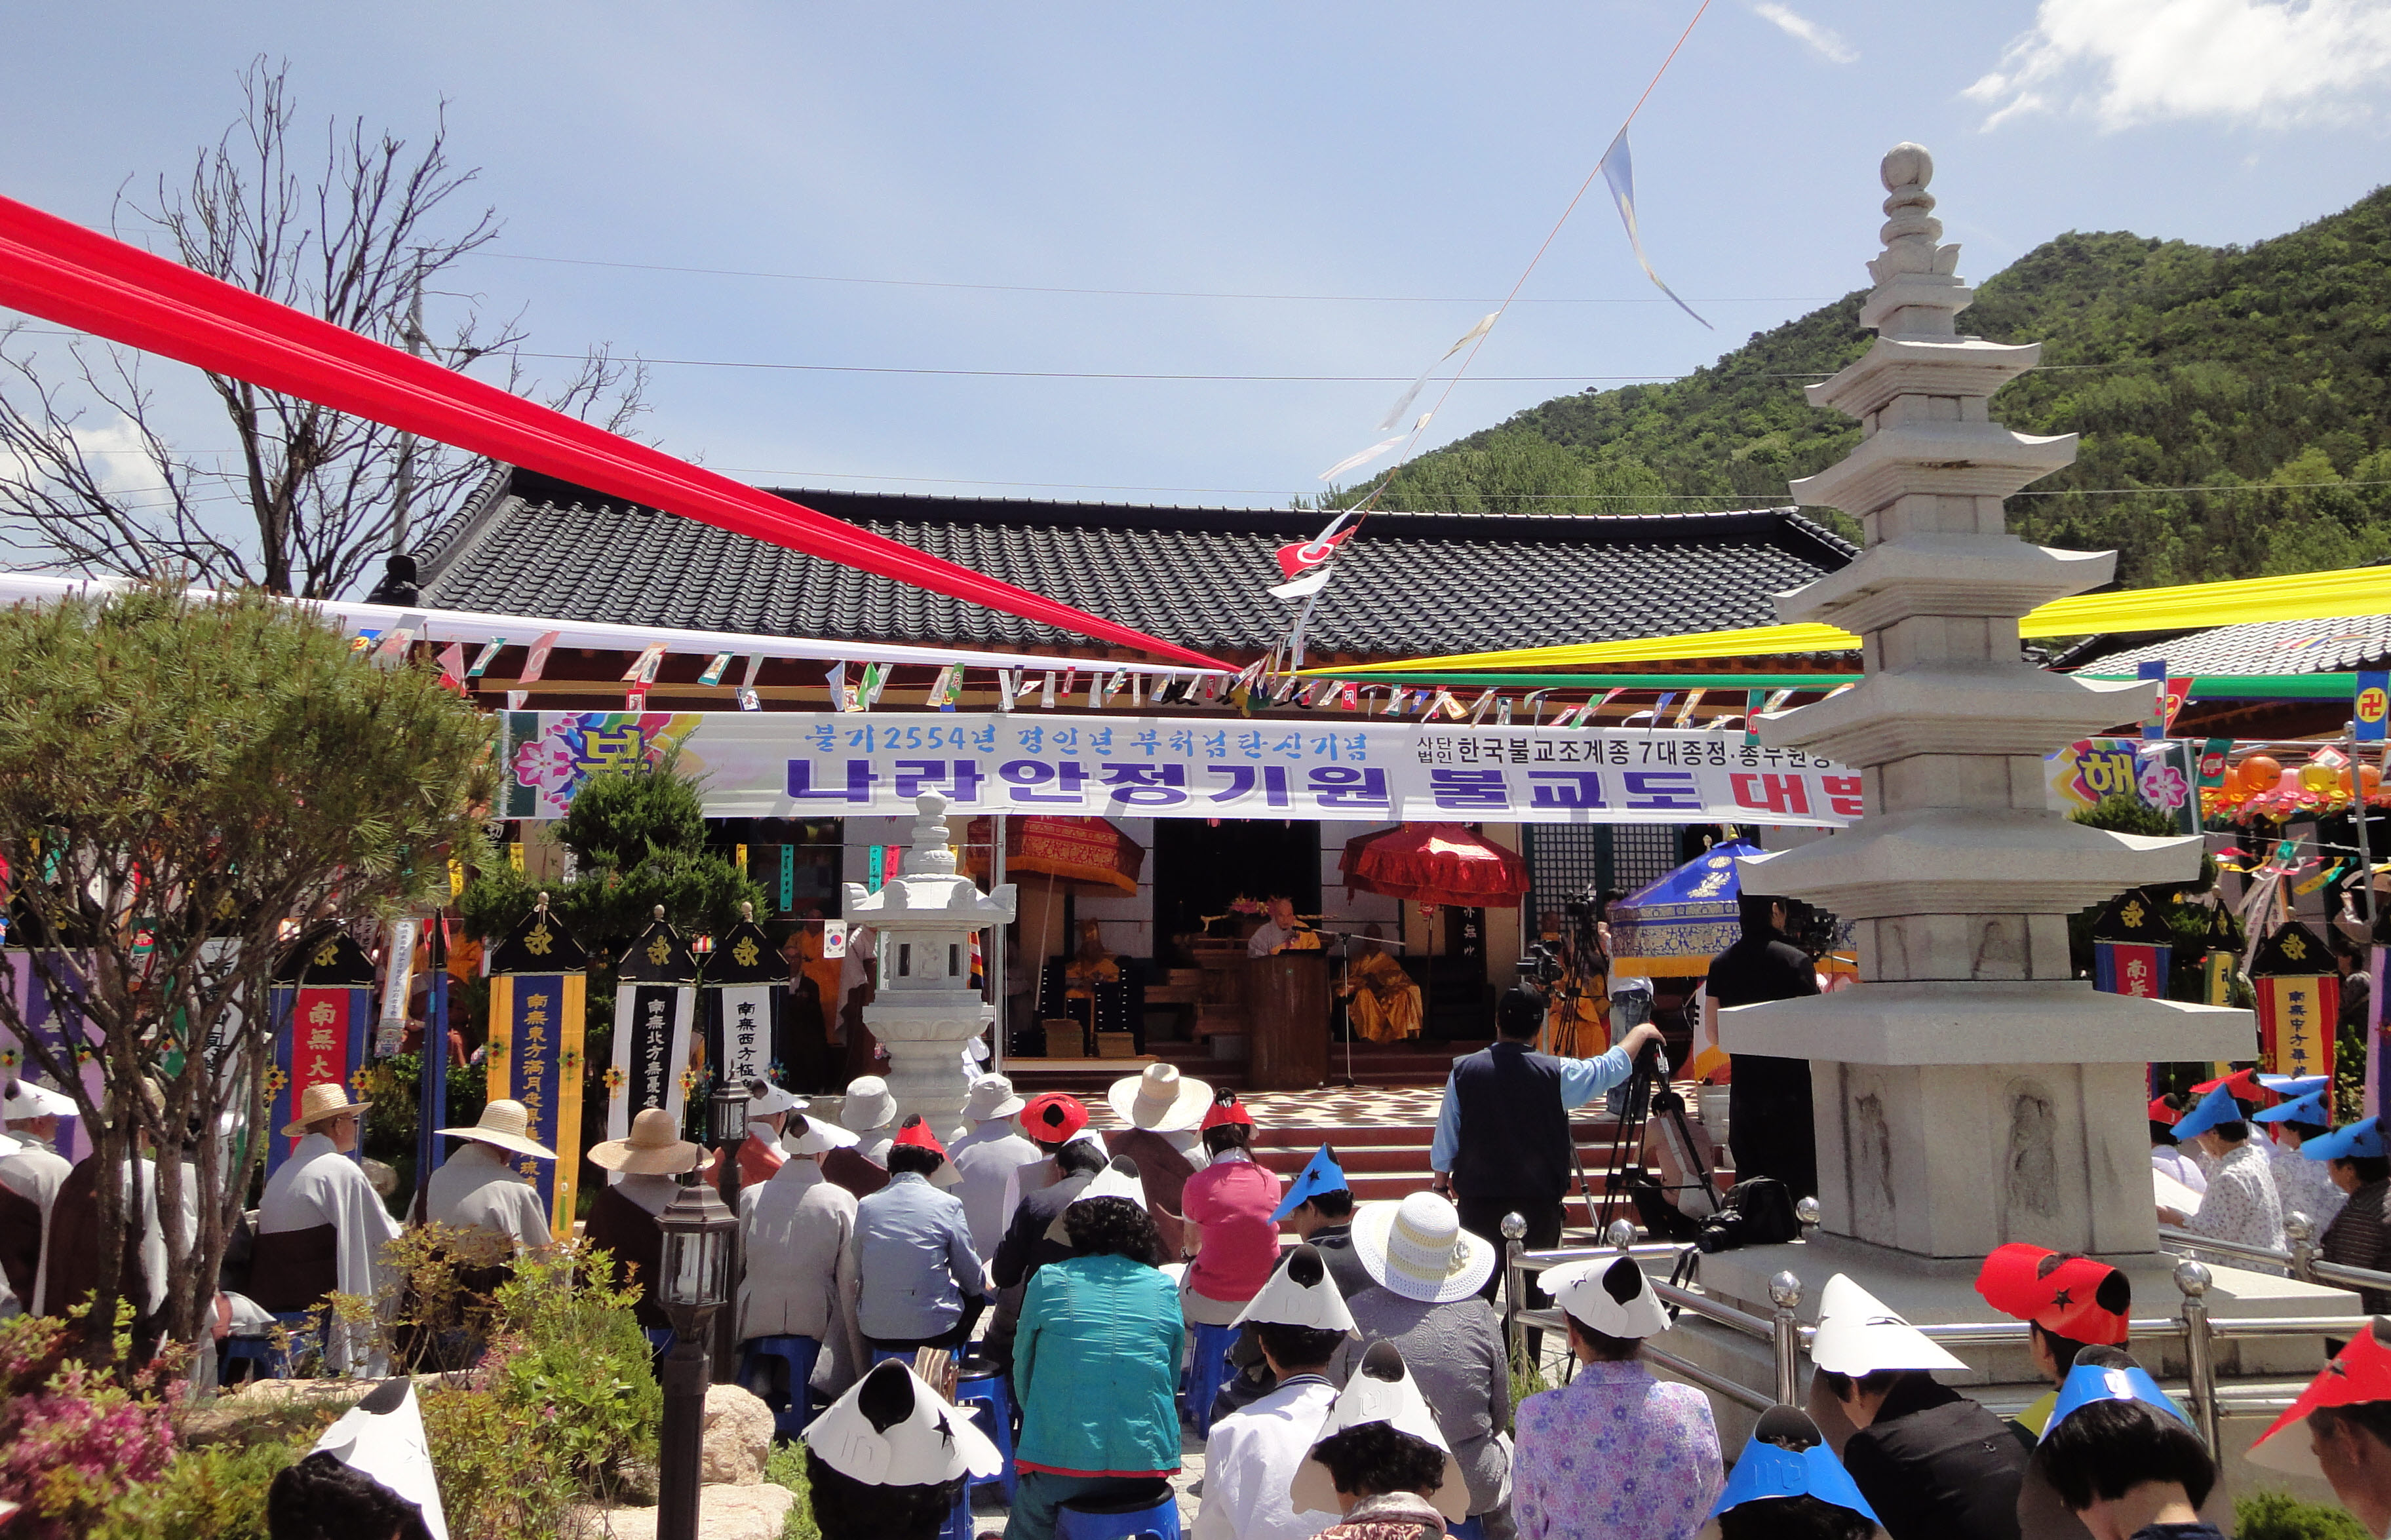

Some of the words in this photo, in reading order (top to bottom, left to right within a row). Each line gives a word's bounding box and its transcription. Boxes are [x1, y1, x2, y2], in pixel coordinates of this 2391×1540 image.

[1017, 725, 1113, 756] 경인년
[1417, 737, 1452, 750] 사단
[1457, 737, 1630, 765] 한국불교조계종
[1418, 750, 1453, 764] 법인
[305, 1001, 337, 1089] 南無大
